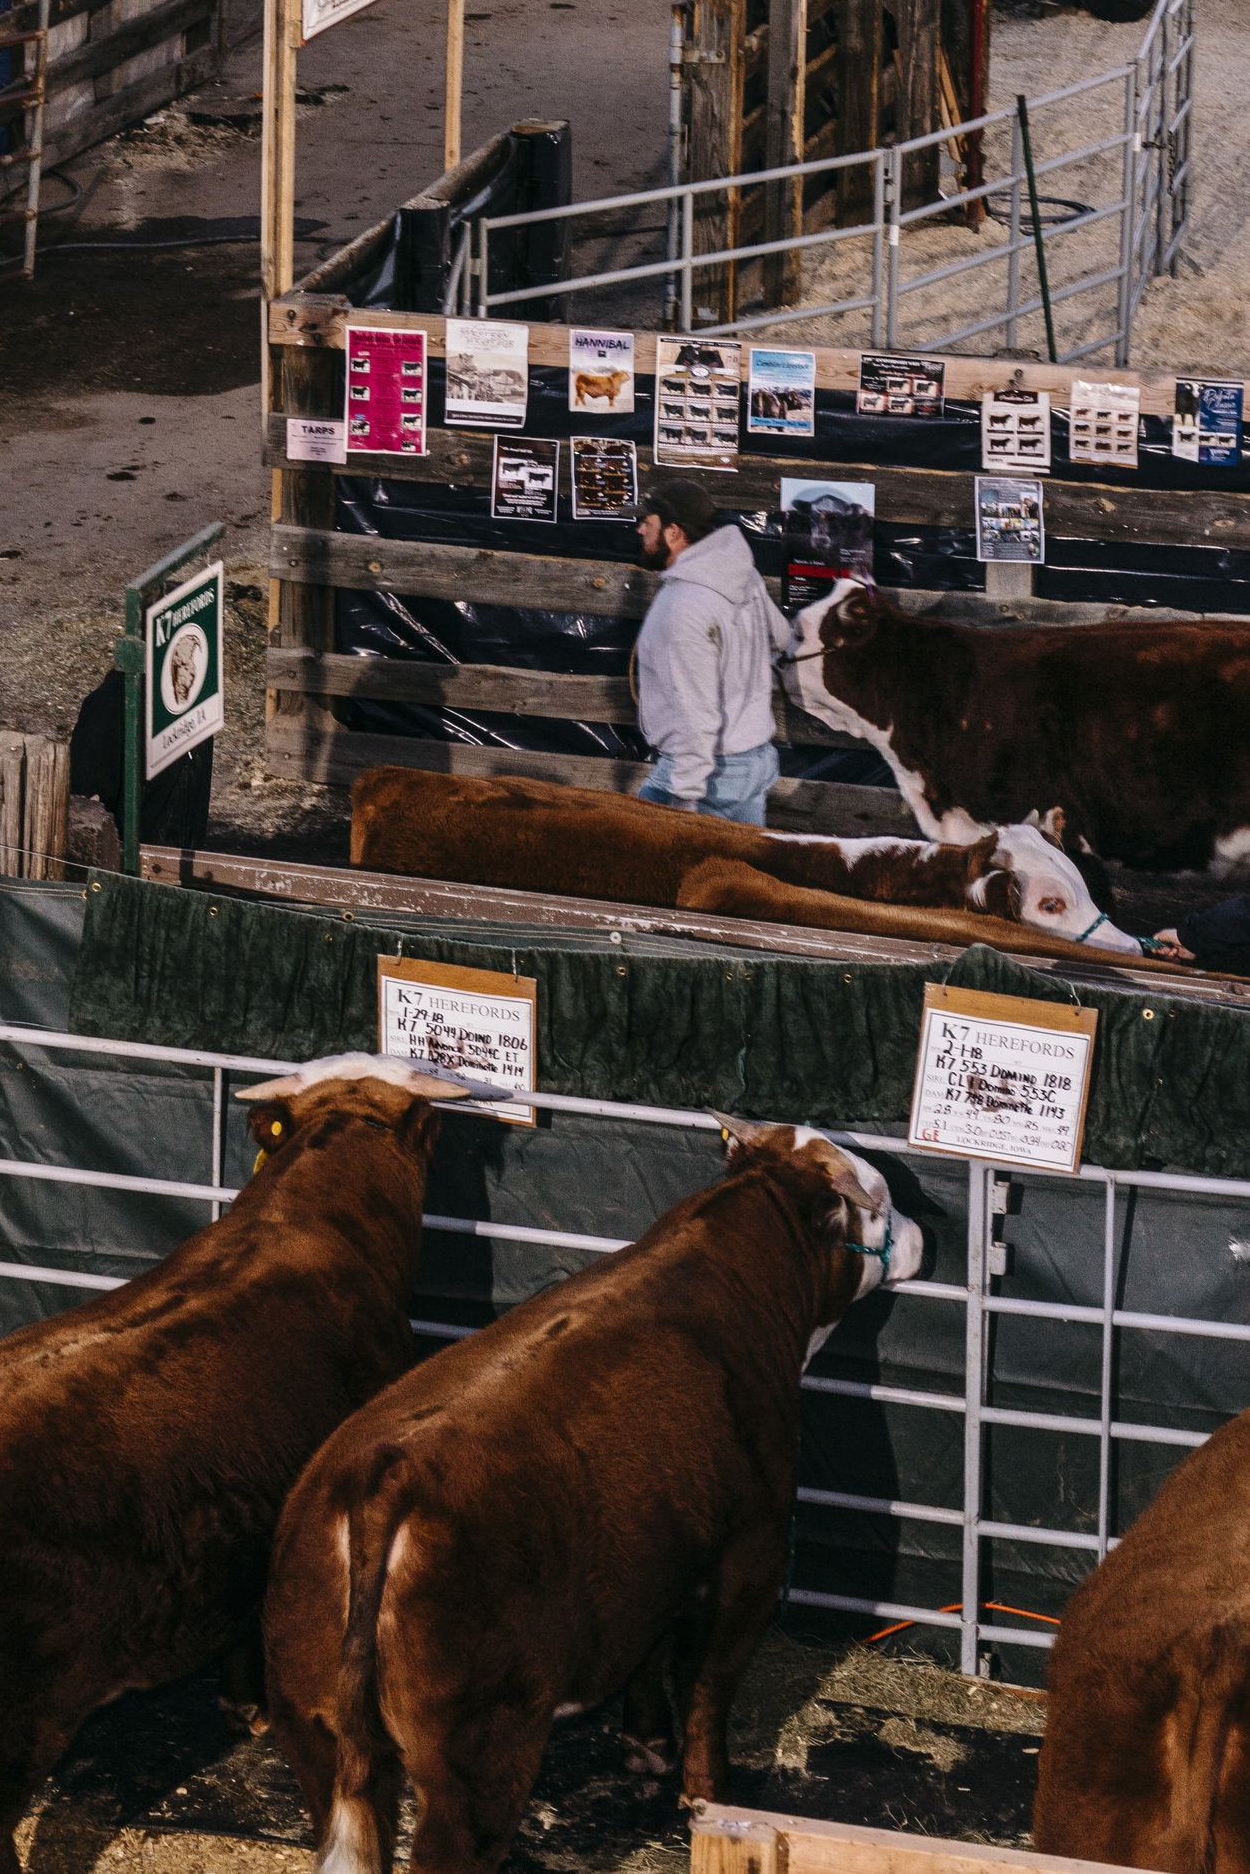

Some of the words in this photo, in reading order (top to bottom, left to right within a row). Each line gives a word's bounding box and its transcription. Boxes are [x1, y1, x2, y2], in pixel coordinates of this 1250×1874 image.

[574, 337, 631, 350] HANNIBAL
[301, 426, 336, 435] TARPS
[397, 988, 423, 1006] K7
[429, 996, 521, 1022] HEREFORDS
[403, 1007, 445, 1024] 1-29-18
[397, 1017, 417, 1032] K7
[425, 1023, 457, 1038] 5044
[498, 1034, 528, 1051] 1806
[941, 1021, 971, 1040] K7
[975, 1031, 1075, 1060] HEREFORDS
[409, 1034, 425, 1046] HH
[505, 1053, 519, 1063] ET
[410, 1047, 424, 1060] K7
[942, 1040, 983, 1060] 2-1-18
[936, 1054, 956, 1071] K7
[959, 1060, 987, 1076] 553
[1043, 1073, 1072, 1091] 1818
[945, 1088, 961, 1101] K7
[948, 1071, 965, 1088] CL
[1021, 1086, 1057, 1104] 553C
[922, 1127, 940, 1142] GE
